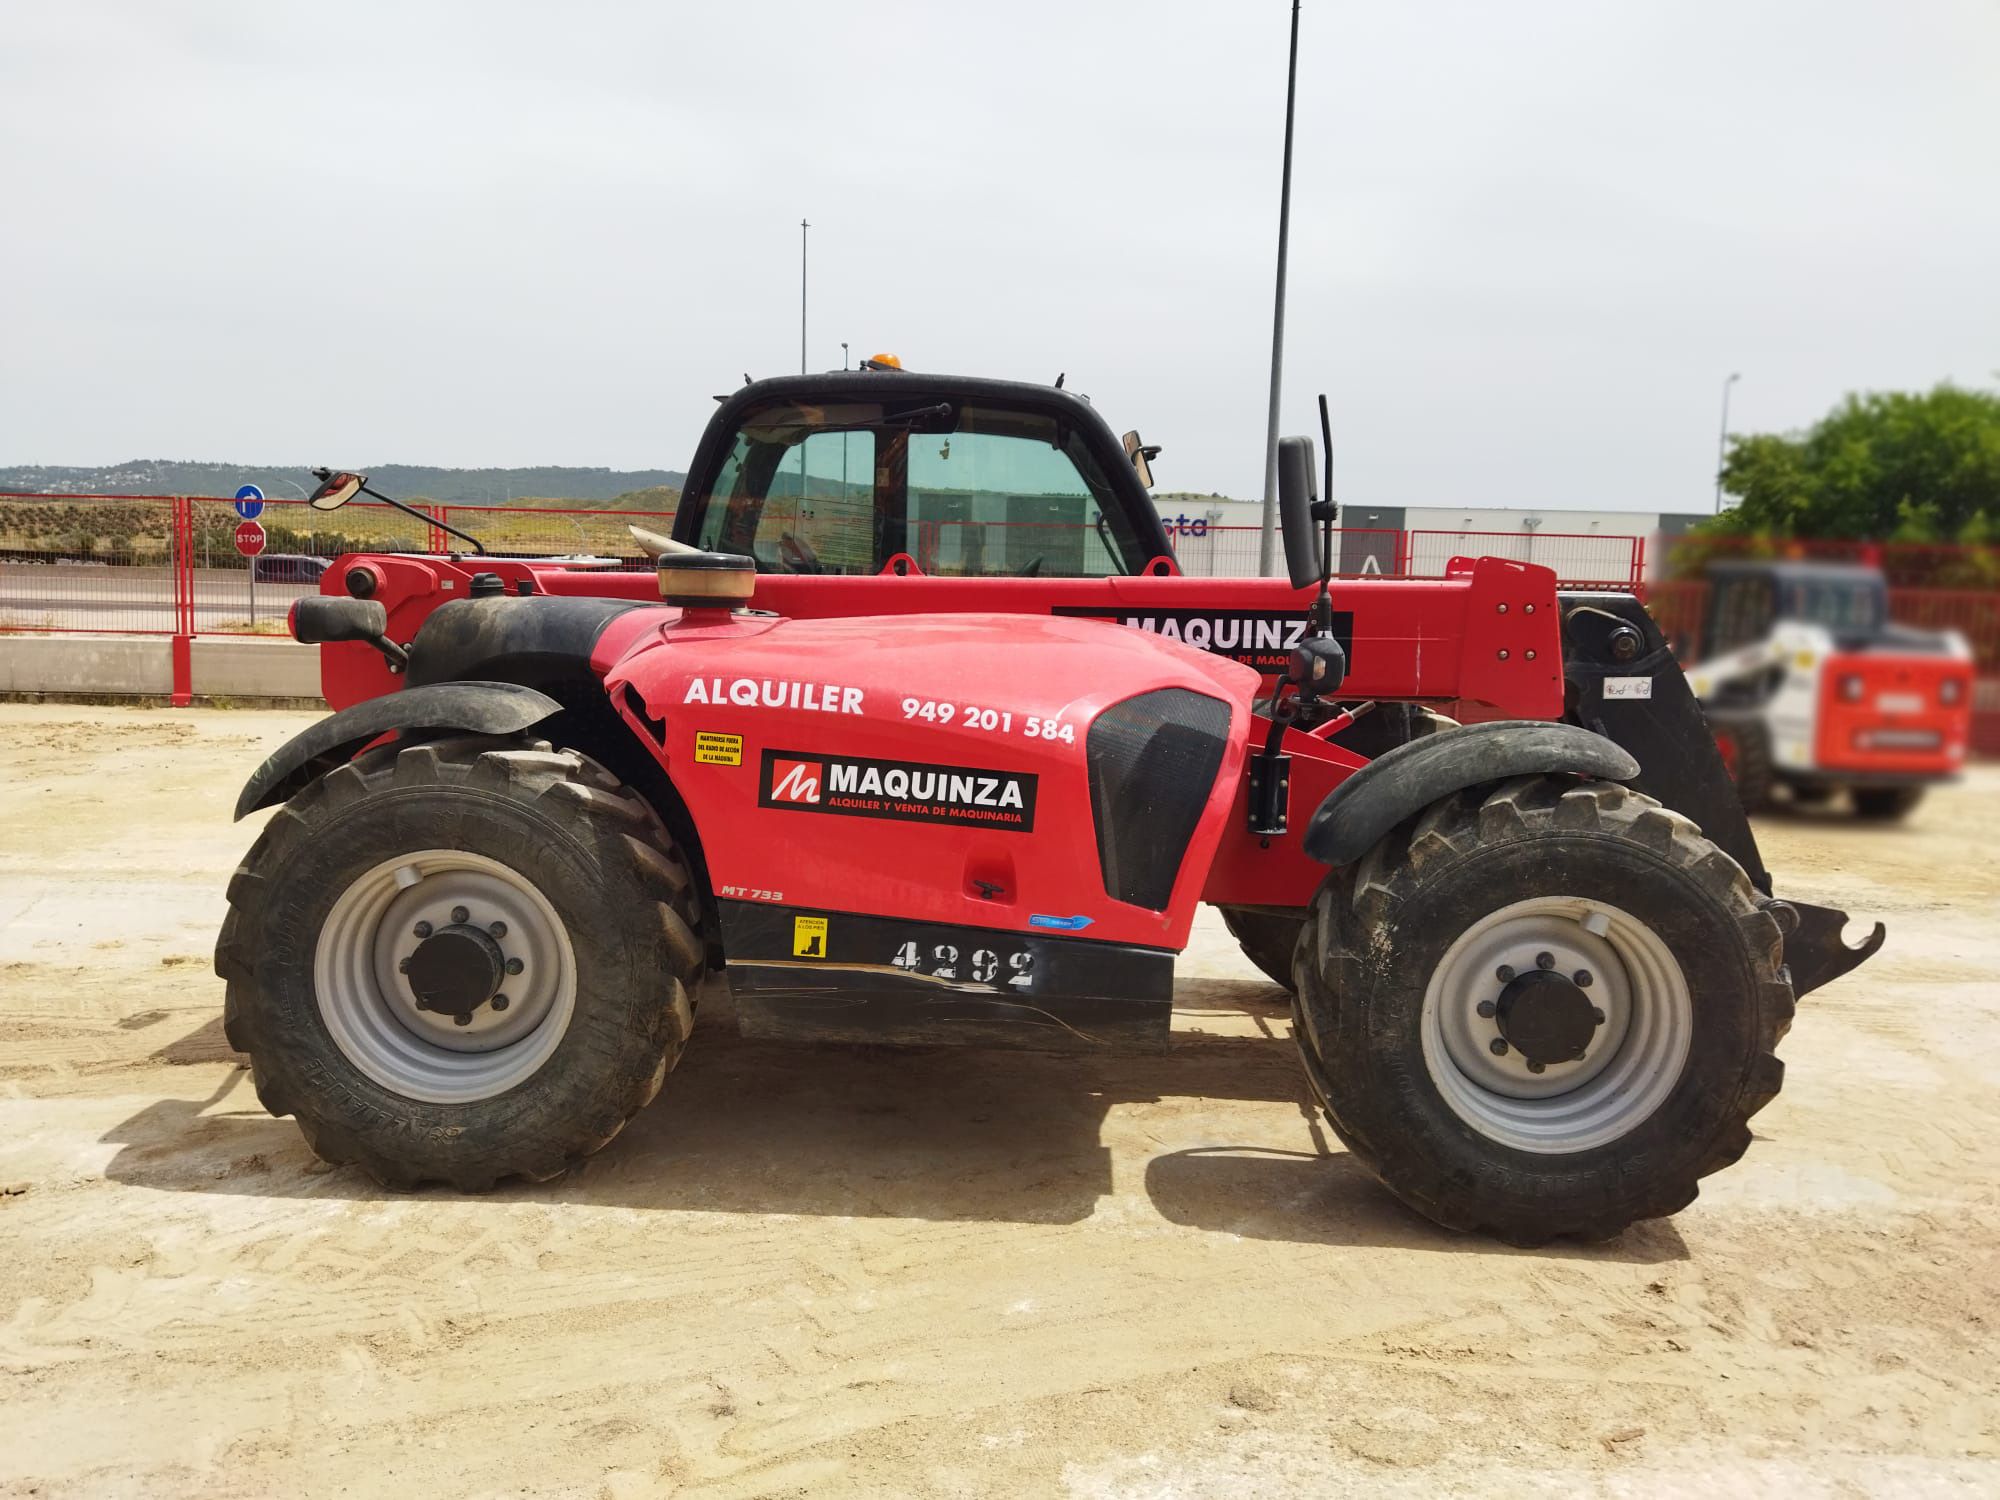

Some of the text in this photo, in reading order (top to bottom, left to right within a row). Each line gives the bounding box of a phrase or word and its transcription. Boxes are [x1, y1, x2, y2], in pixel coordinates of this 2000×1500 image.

[237, 534, 263, 543] STOP
[683, 678, 864, 715] ALQUILER
[901, 698, 1076, 744] 949 201 584
[829, 763, 1024, 808] MAQUINZA
[828, 797, 1022, 824] ALQUILER Y VENTA DE MAQUINARIA
[721, 885, 783, 901] MT 733
[891, 941, 1035, 986] 4292
